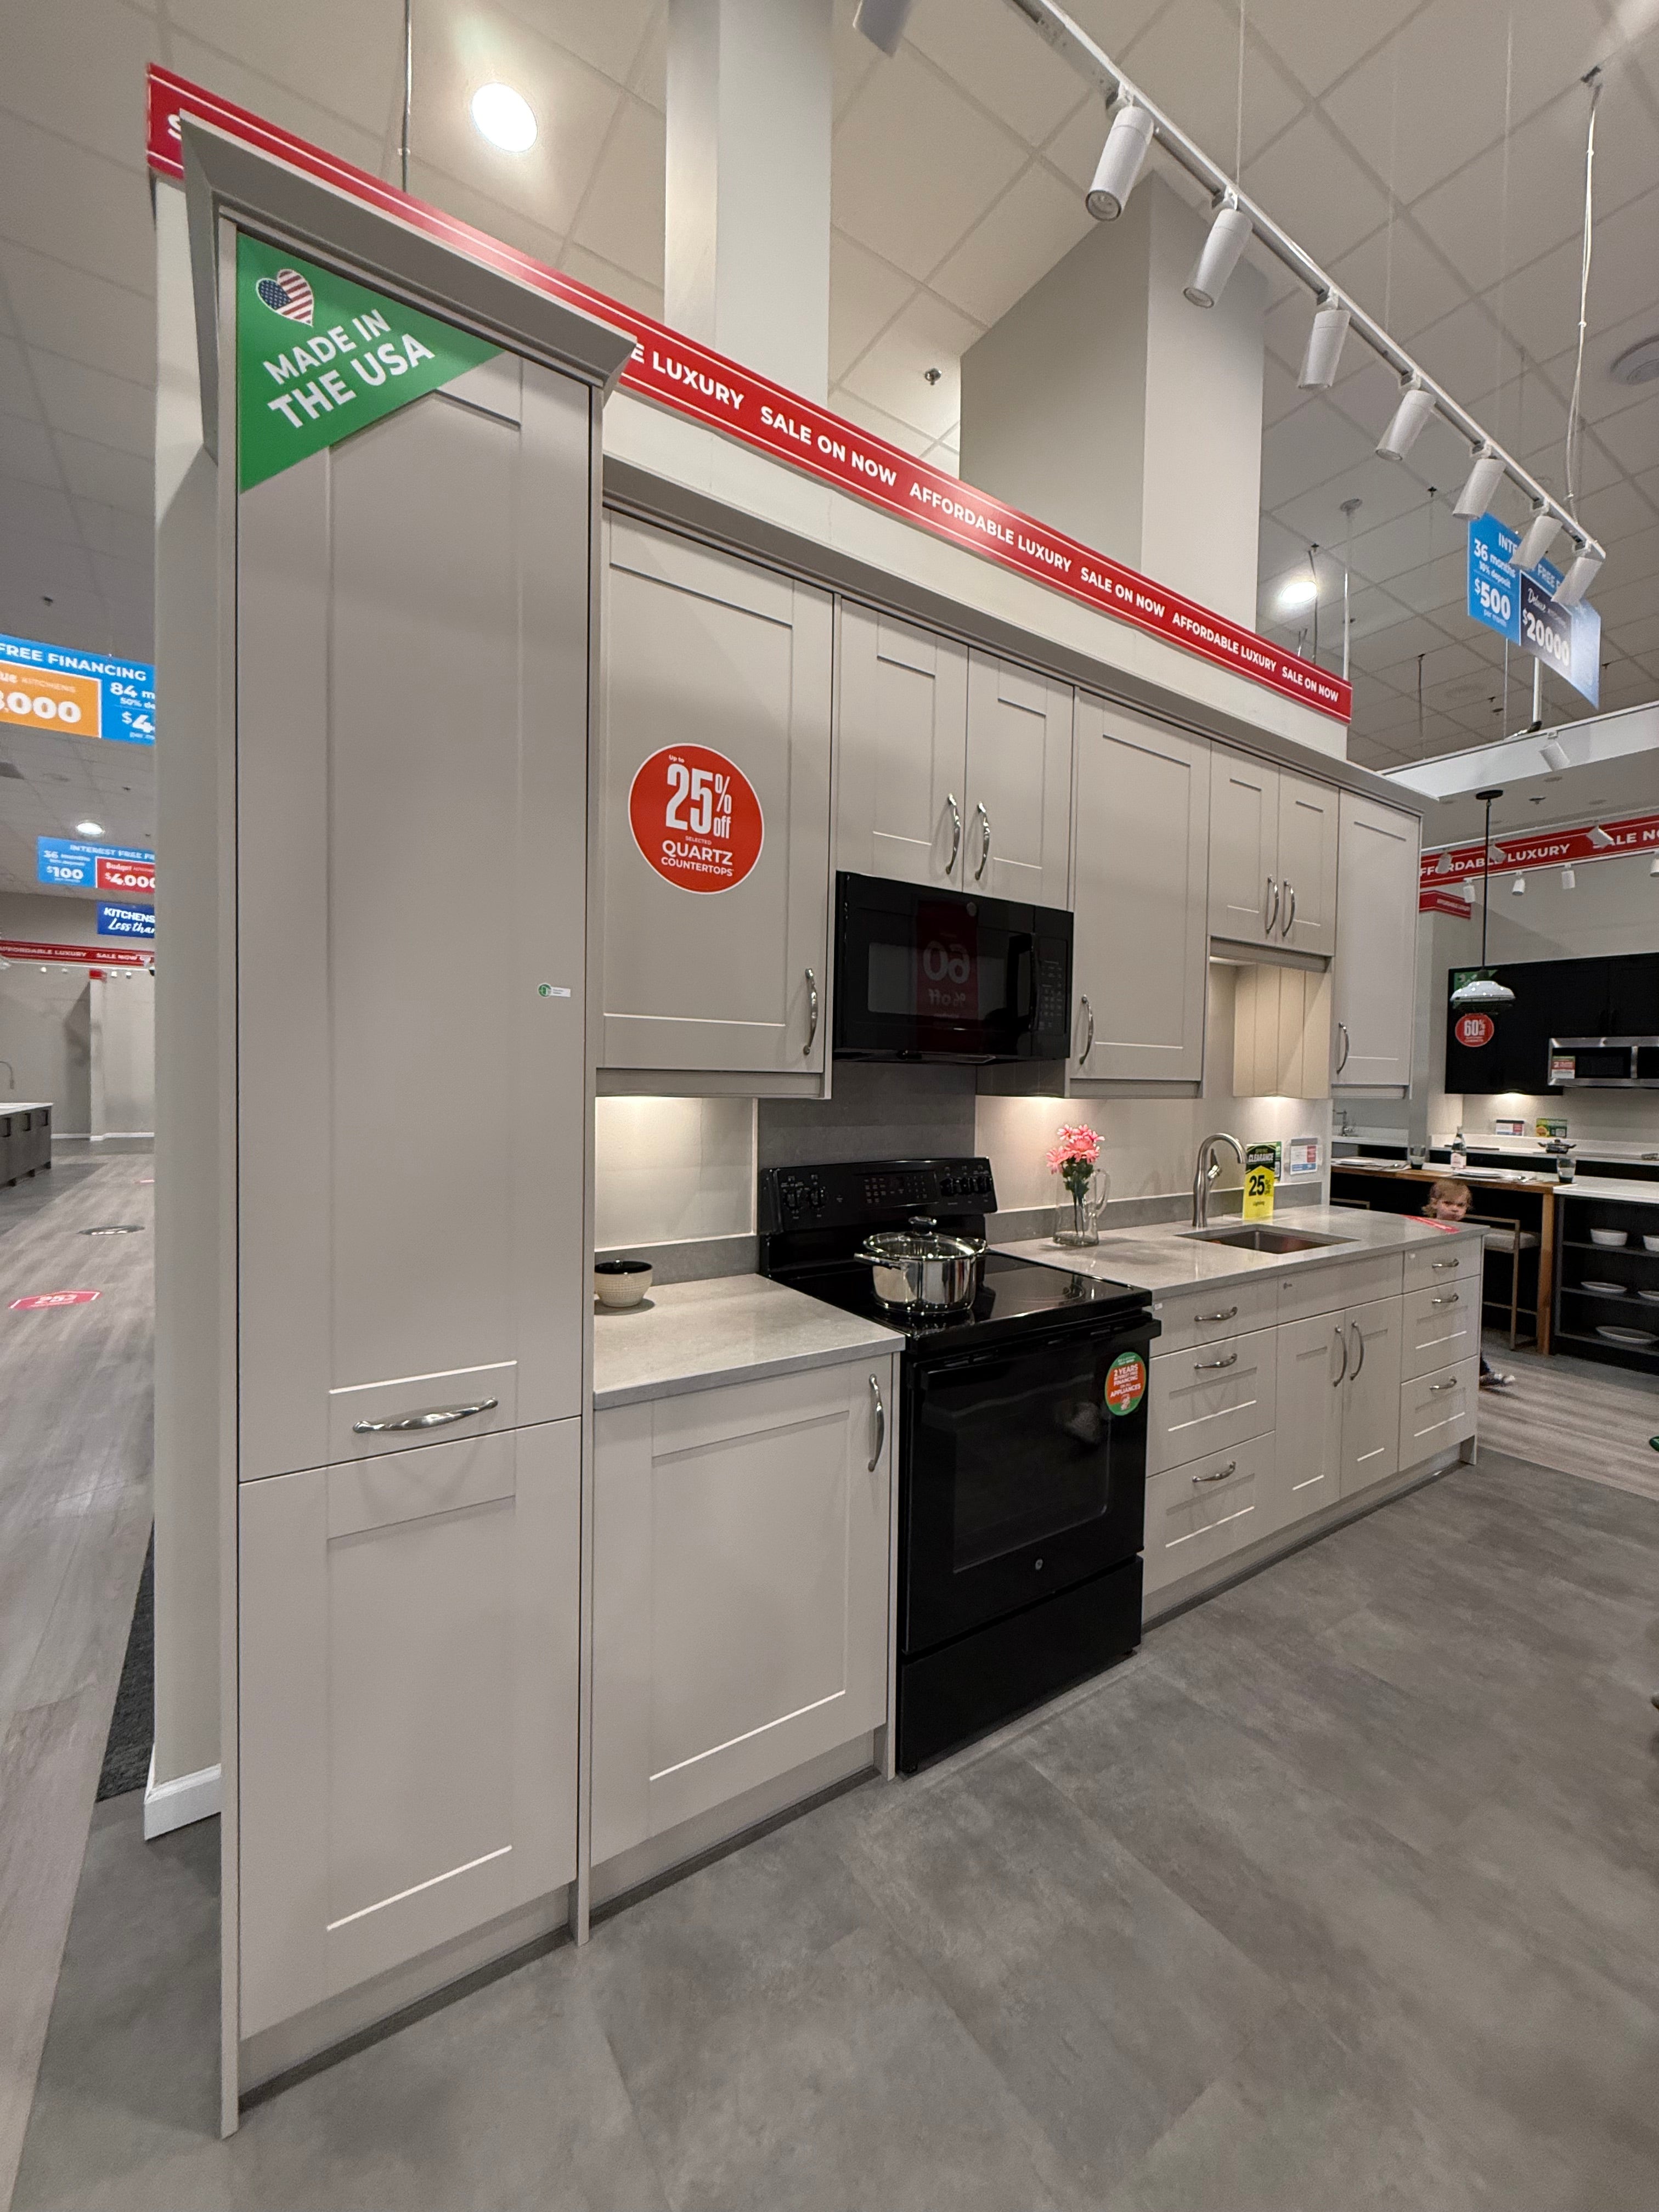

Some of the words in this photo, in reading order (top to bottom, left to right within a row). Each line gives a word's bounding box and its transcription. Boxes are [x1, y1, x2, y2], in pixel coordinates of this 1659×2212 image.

[263, 325, 356, 385] MADE
[352, 309, 391, 342] IN
[267, 370, 357, 428] THE
[350, 333, 436, 386] USA
[653, 351, 744, 409] LUXURY
[761, 406, 811, 445] SALE
[818, 435, 845, 461] ON
[852, 451, 896, 486] NOW
[910, 482, 1014, 545] AFFORDABLE
[1018, 535, 1071, 572] LUXURY
[1081, 567, 1112, 593] SALE
[1115, 584, 1133, 602] ON
[1136, 595, 1165, 617] NOW
[1172, 612, 1239, 655] AFFORDABLE
[1241, 647, 1277, 672] LUXURY
[1282, 665, 1303, 684] SALE
[1305, 677, 1317, 691] ON
[1318, 684, 1339, 702] NOW
[1474, 538, 1488, 561] 36
[1538, 563, 1555, 588] FREE
[1475, 578, 1511, 620] $500
[48, 653, 146, 681] FINANCING
[110, 682, 137, 698] 84
[713, 815, 731, 839] off
[685, 836, 712, 845] SELECTED
[662, 839, 733, 866] QUARTZ
[1508, 843, 1570, 862] LUXURY
[47, 866, 84, 880] $100
[104, 907, 155, 923] KITCHENS
[108, 917, 132, 932] Less
[1249, 1153, 1273, 1163] CLEARANCE
[1249, 1175, 1265, 1197] 25
